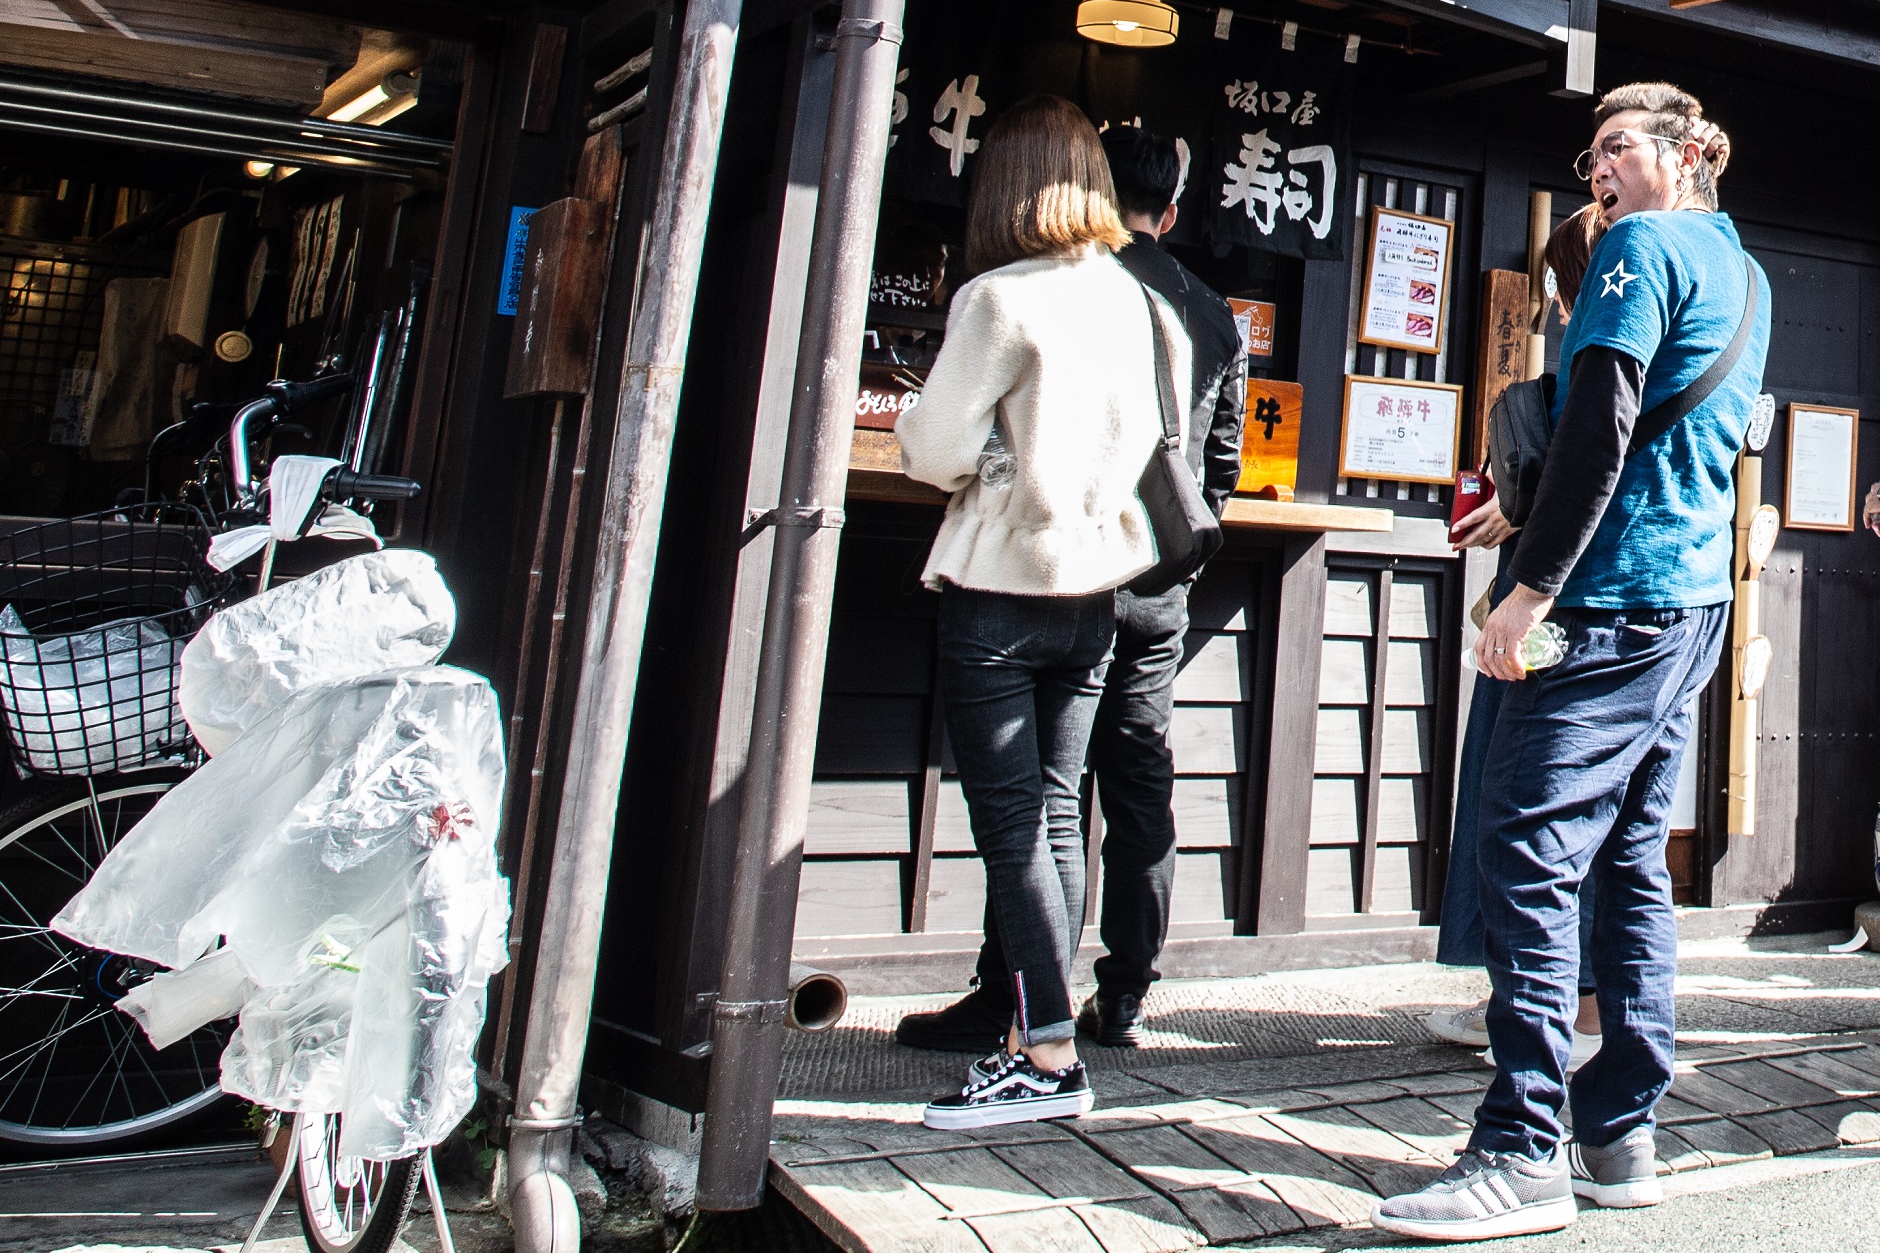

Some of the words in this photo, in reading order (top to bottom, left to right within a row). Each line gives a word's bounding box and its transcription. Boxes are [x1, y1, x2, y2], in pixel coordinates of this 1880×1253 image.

[1224, 78, 1321, 126] 坂口屋
[1220, 128, 1337, 239] 寿司
[1255, 397, 1282, 440] 牛
[1376, 396, 1431, 423] 飛騨牛
